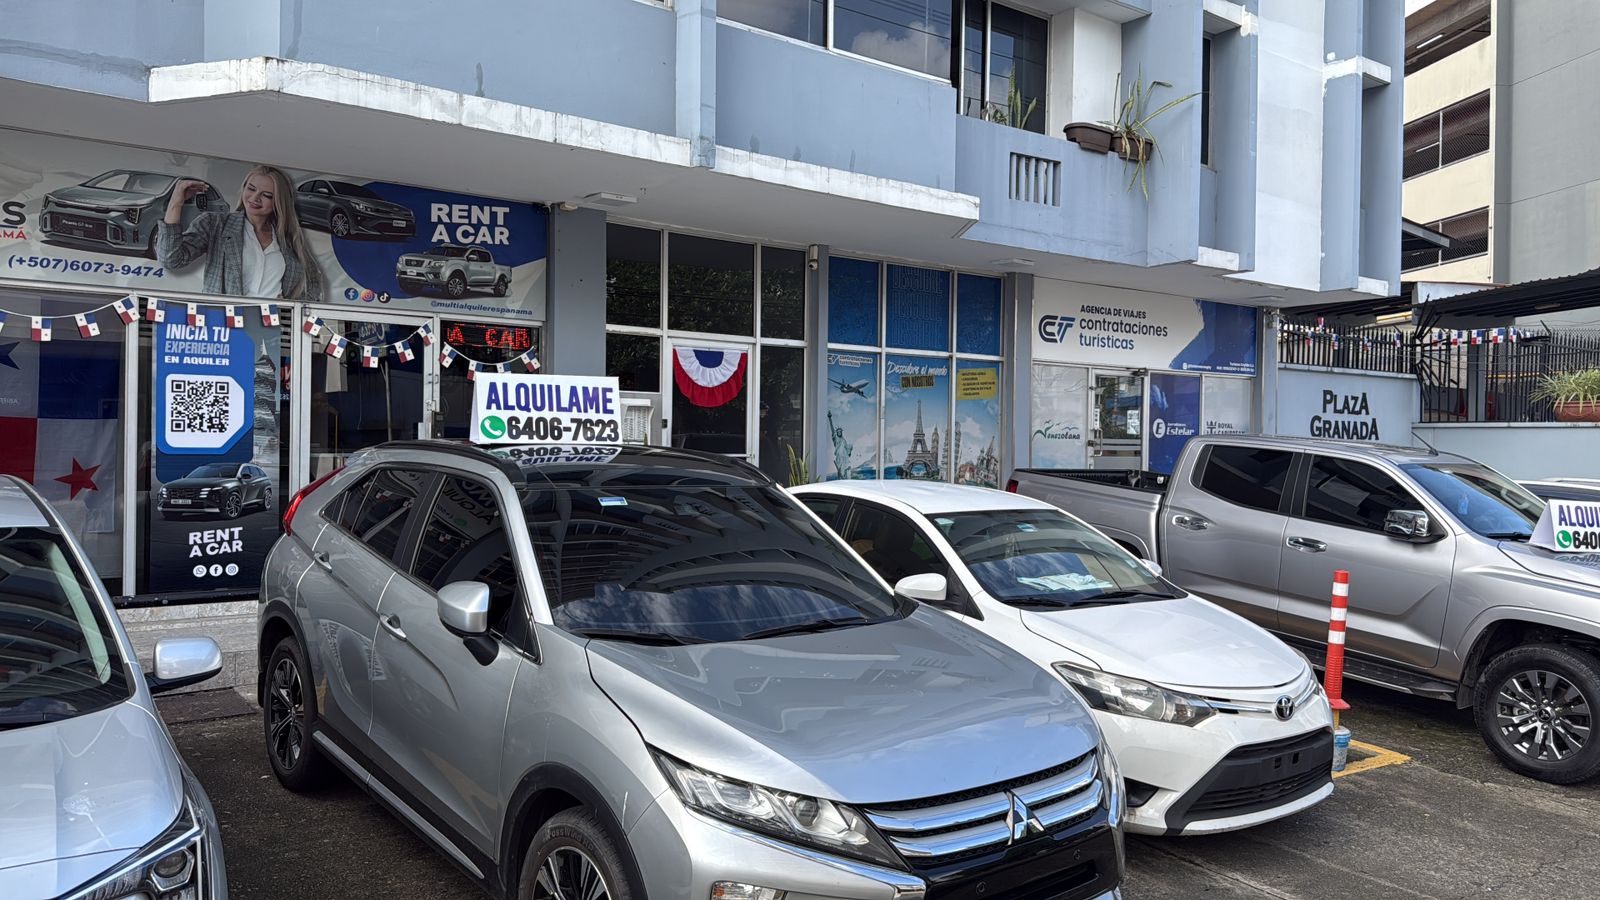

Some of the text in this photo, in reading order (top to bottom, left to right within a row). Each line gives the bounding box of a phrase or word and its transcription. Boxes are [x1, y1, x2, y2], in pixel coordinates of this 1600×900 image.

[431, 203, 510, 225] RENT
[0, 227, 27, 240] MÁ
[431, 224, 510, 245] A CAR
[8, 254, 164, 278] (+507)6073-9474
[431, 300, 533, 315] @multialquilerespanama
[1080, 305, 1147, 319] AGENCIA DE VIAJES
[165, 323, 230, 342] INICIA TU
[1080, 318, 1168, 337] contrataciones
[485, 328, 530, 349] CAR
[165, 341, 230, 356] EXPERIENCIA
[164, 355, 230, 366] EN AQUILER
[887, 360, 920, 375] Descubre
[920, 364, 928, 375] el
[486, 382, 614, 414] ALQUILAME
[1322, 389, 1370, 415] PLAZA
[507, 416, 620, 442] 6406-7623
[1166, 427, 1195, 436] Estelar
[1310, 415, 1379, 440] GRANADA
[1558, 504, 1600, 528] ALQUI
[188, 526, 243, 545] RENT
[1572, 530, 1600, 550] 640
[189, 540, 243, 558] A CAR
